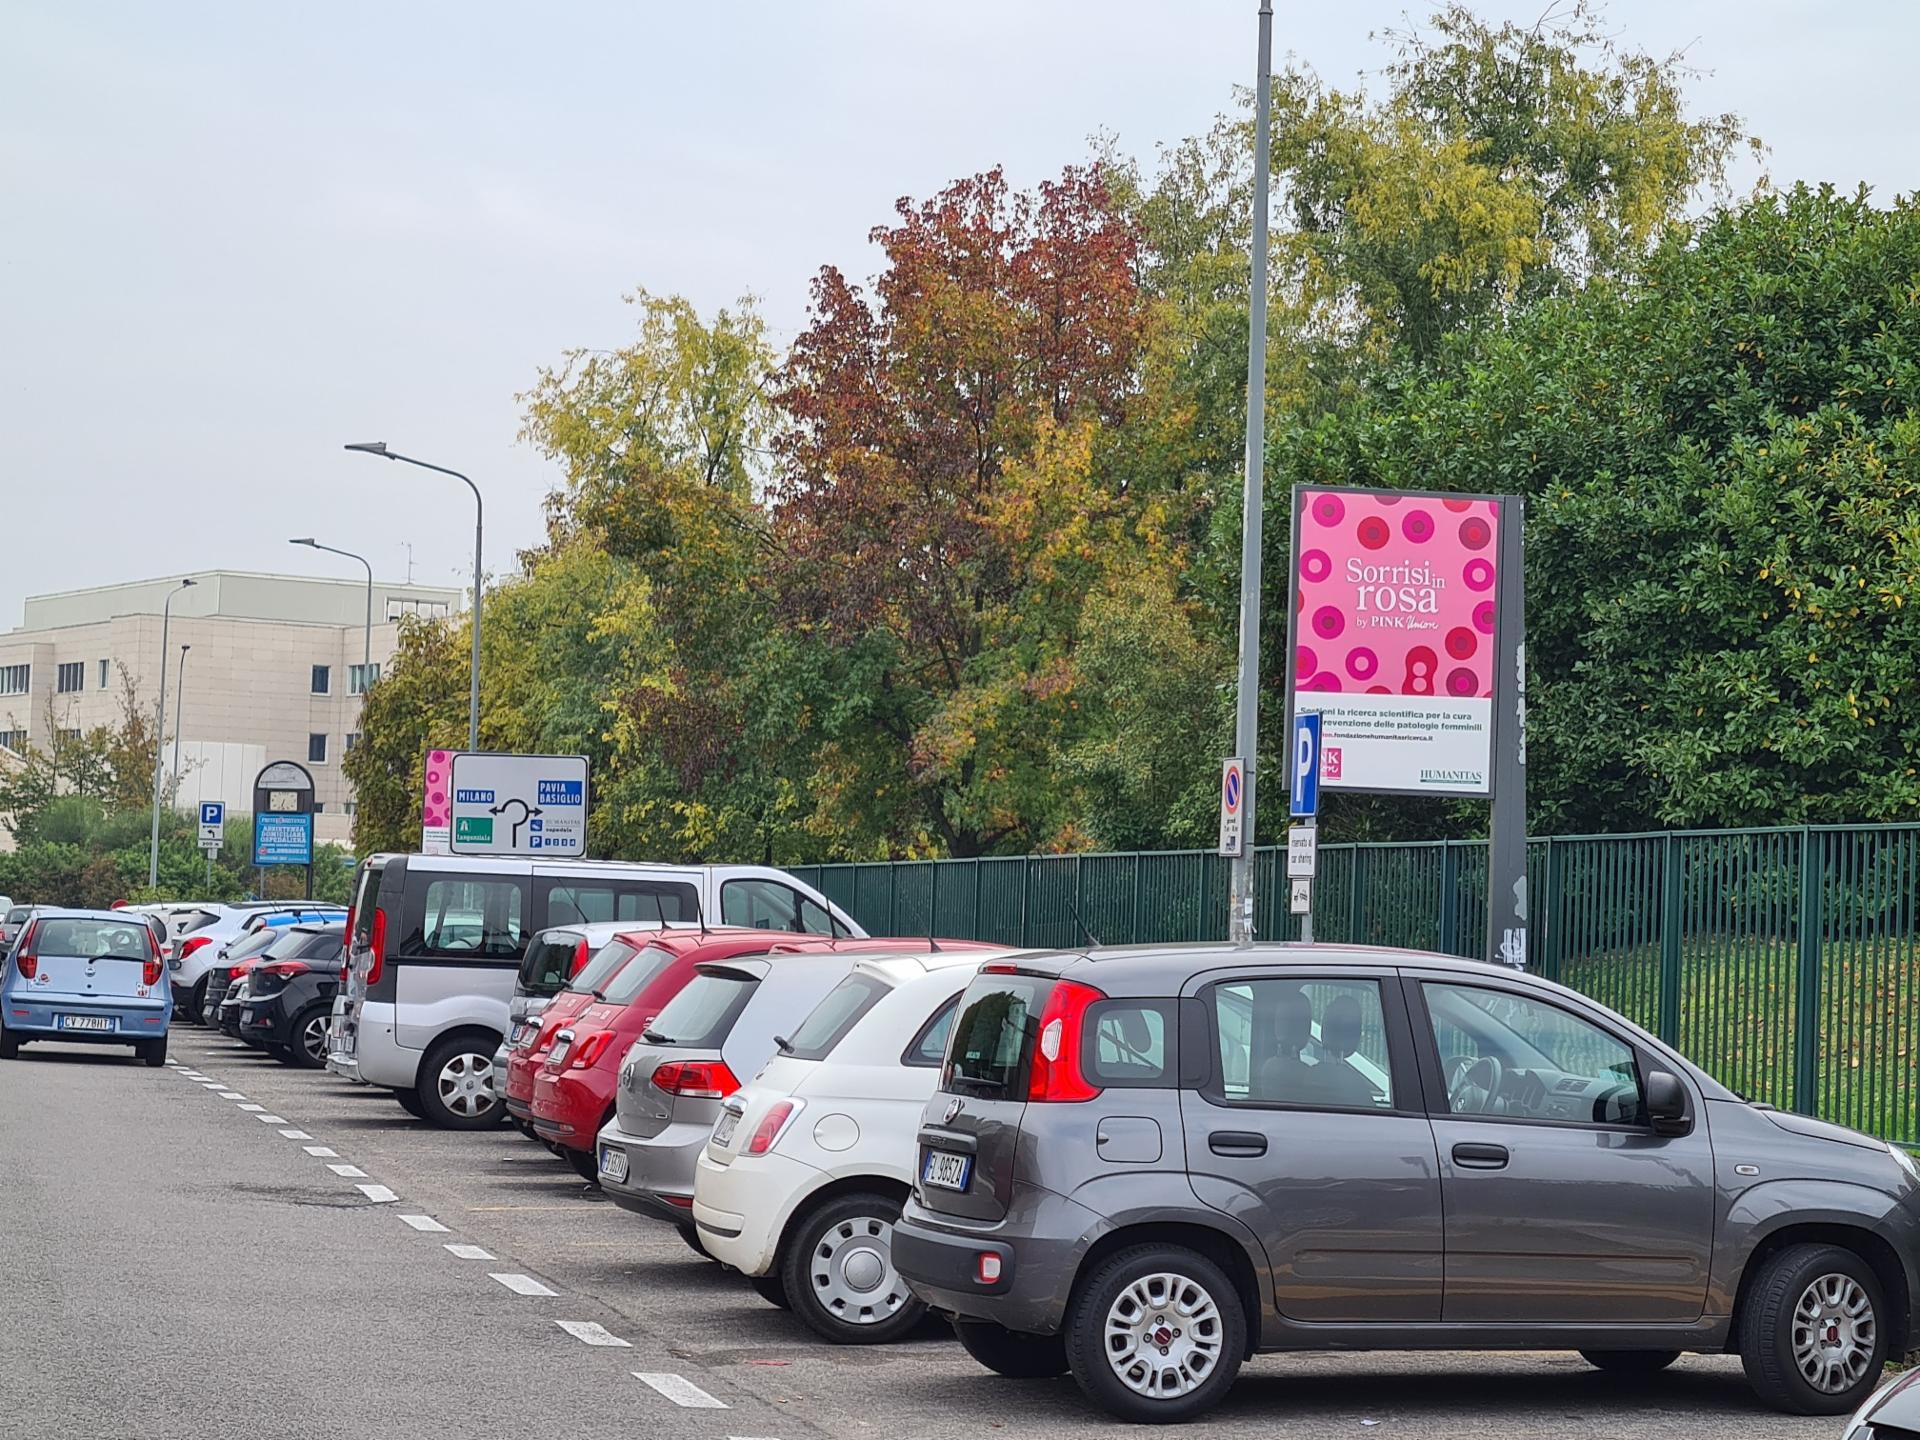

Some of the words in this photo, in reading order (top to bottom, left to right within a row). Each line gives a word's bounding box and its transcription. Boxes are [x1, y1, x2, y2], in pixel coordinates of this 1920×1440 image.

[1346, 557, 1431, 585] Sorrisi
[1431, 573, 1446, 588] in
[1356, 585, 1439, 614] rosa
[1356, 617, 1367, 629] by
[1371, 615, 1404, 628] PINK
[1406, 615, 1439, 630] Union
[1337, 708, 1346, 716] la
[1347, 708, 1377, 717] ricerca
[1379, 710, 1424, 719] scientifica
[1426, 711, 1441, 720] per
[1442, 711, 1451, 719] la
[1452, 712, 1472, 720] cura
[1323, 719, 1372, 727] revenzione
[1373, 720, 1395, 728] delle
[1396, 721, 1439, 731] patologie
[1440, 722, 1482, 731] femminili
[1296, 727, 1313, 802] P
[1420, 769, 1482, 780] HUMANITAS
[540, 782, 566, 793] PAVIA
[458, 791, 493, 801] MILANO
[539, 793, 581, 803] BASIGLIO
[206, 806, 218, 821] P
[532, 837, 541, 847] P
